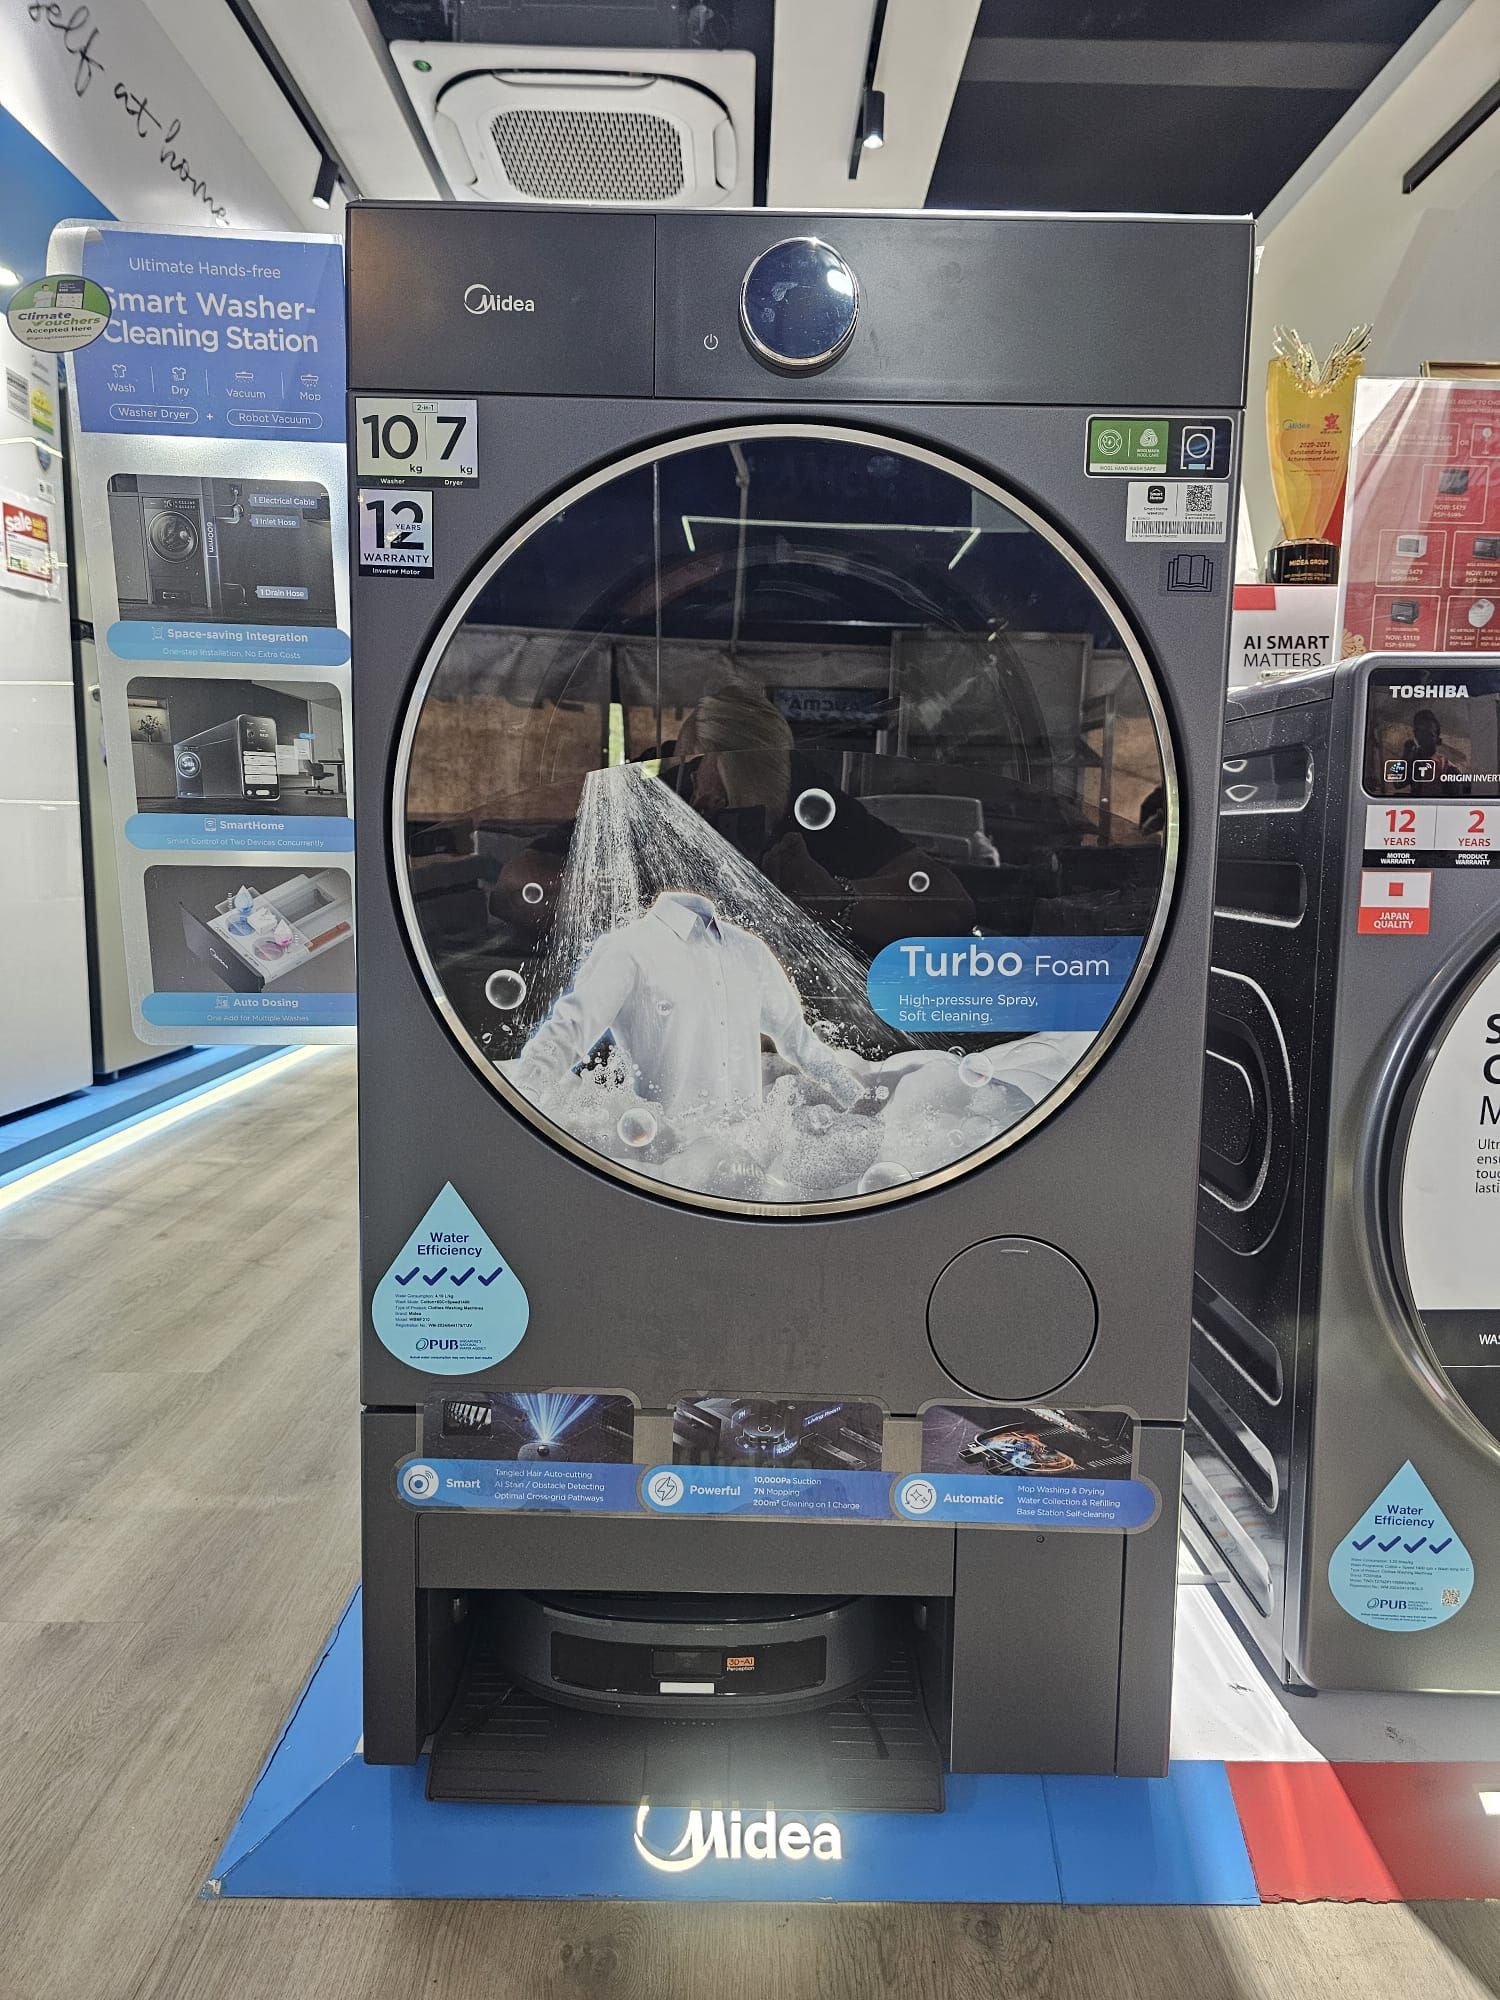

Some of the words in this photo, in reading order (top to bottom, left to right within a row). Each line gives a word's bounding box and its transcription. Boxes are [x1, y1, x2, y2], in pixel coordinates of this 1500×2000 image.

[114, 82, 161, 138] at
[129, 257, 194, 275] Ultimate
[199, 260, 281, 279] Hands-free
[464, 283, 535, 315] Midea
[196, 292, 316, 320] Washer-
[18, 311, 71, 321] Climate
[103, 320, 218, 352] Cleaning
[226, 326, 318, 353] Station
[107, 383, 135, 393] Wash
[171, 385, 189, 397] Dry
[226, 388, 266, 399] Vacuum
[416, 404, 434, 412] 2-in-1
[118, 407, 157, 418] Washer
[161, 409, 190, 421] Dryer
[238, 412, 269, 423] Robot
[272, 414, 311, 425] Vacuum
[362, 414, 419, 460] 10
[436, 416, 467, 461] 7
[409, 464, 423, 474] kg
[460, 465, 473, 475] kg
[259, 496, 292, 505] Electrical
[294, 497, 316, 506] Cable
[5, 510, 33, 532] sale
[260, 518, 277, 526] Inlet
[278, 518, 297, 526] Hose
[366, 500, 425, 551] 12
[395, 523, 422, 531] YEARS
[363, 553, 430, 564] WARRANTY
[265, 589, 285, 597] Drain
[167, 629, 243, 642] Space-saving
[246, 632, 309, 643] Integration
[1243, 636, 1261, 649] AI
[1266, 636, 1330, 649] SMART
[278, 651, 301, 660] Costs
[1243, 653, 1326, 667] MATTERS.
[1389, 685, 1470, 699] TOSHIBA
[1440, 774, 1472, 782] ORIGIN
[219, 820, 285, 831] SmartHome
[1385, 809, 1416, 833] 12
[1467, 810, 1486, 833] 2
[166, 837, 190, 846] Smart
[191, 838, 219, 846] Control
[230, 838, 246, 847] Two
[247, 838, 276, 847] Devices
[278, 839, 325, 848] Concurrently
[1383, 837, 1416, 846] YEARS
[1458, 838, 1491, 847] YEARS
[1379, 912, 1410, 920] JAPAN
[1373, 921, 1414, 930] QUALITY
[900, 945, 1023, 977] Turbo
[1035, 955, 1110, 976] Foam
[233, 998, 259, 1008] Auto
[262, 998, 299, 1009] Dosing
[899, 994, 993, 1008] High-pressure
[997, 994, 1039, 1008] Spray,
[252, 1015, 280, 1023] Multiple
[281, 1015, 309, 1023] Washes
[899, 1010, 927, 1022] Soft
[931, 1010, 993, 1024] Cleaning.
[1476, 1156, 1500, 1164] ens
[430, 1232, 470, 1243] Water
[417, 1245, 482, 1258] Efficiency
[429, 1339, 459, 1351] PUB
[495, 1469, 525, 1478] Tangled
[544, 1470, 593, 1480] Auto-cutting
[446, 1478, 481, 1489] Smart
[495, 1480, 503, 1488] AI
[532, 1482, 566, 1490] Obstacle
[567, 1483, 605, 1492] Detecting
[754, 1476, 791, 1486] 10,000Pa
[792, 1477, 821, 1485] Suction
[690, 1485, 741, 1496] Powerful
[766, 1488, 800, 1498] Mopping
[1017, 1485, 1035, 1495] Mop
[1036, 1486, 1070, 1496] Washing
[1071, 1487, 1077, 1495] &
[1078, 1487, 1105, 1497] Drying
[494, 1492, 525, 1501] Optimal
[526, 1493, 566, 1502] Cross-grid
[568, 1494, 604, 1503] Pathways
[943, 1493, 1004, 1505] Automatic
[1017, 1497, 1041, 1505] Water
[1042, 1498, 1080, 1506] Collection
[1081, 1498, 1087, 1506] &
[1089, 1499, 1121, 1508] Refilling
[781, 1500, 814, 1510] Cleaning
[832, 1502, 860, 1510] Charge
[1387, 1504, 1424, 1515] Water
[1016, 1508, 1036, 1516] Base
[1036, 1509, 1064, 1517] Station
[1065, 1509, 1115, 1519] Self-cleaning
[1374, 1515, 1435, 1529] Efficiency
[1380, 1599, 1407, 1610] PUB
[633, 1803, 843, 1872] Midea
